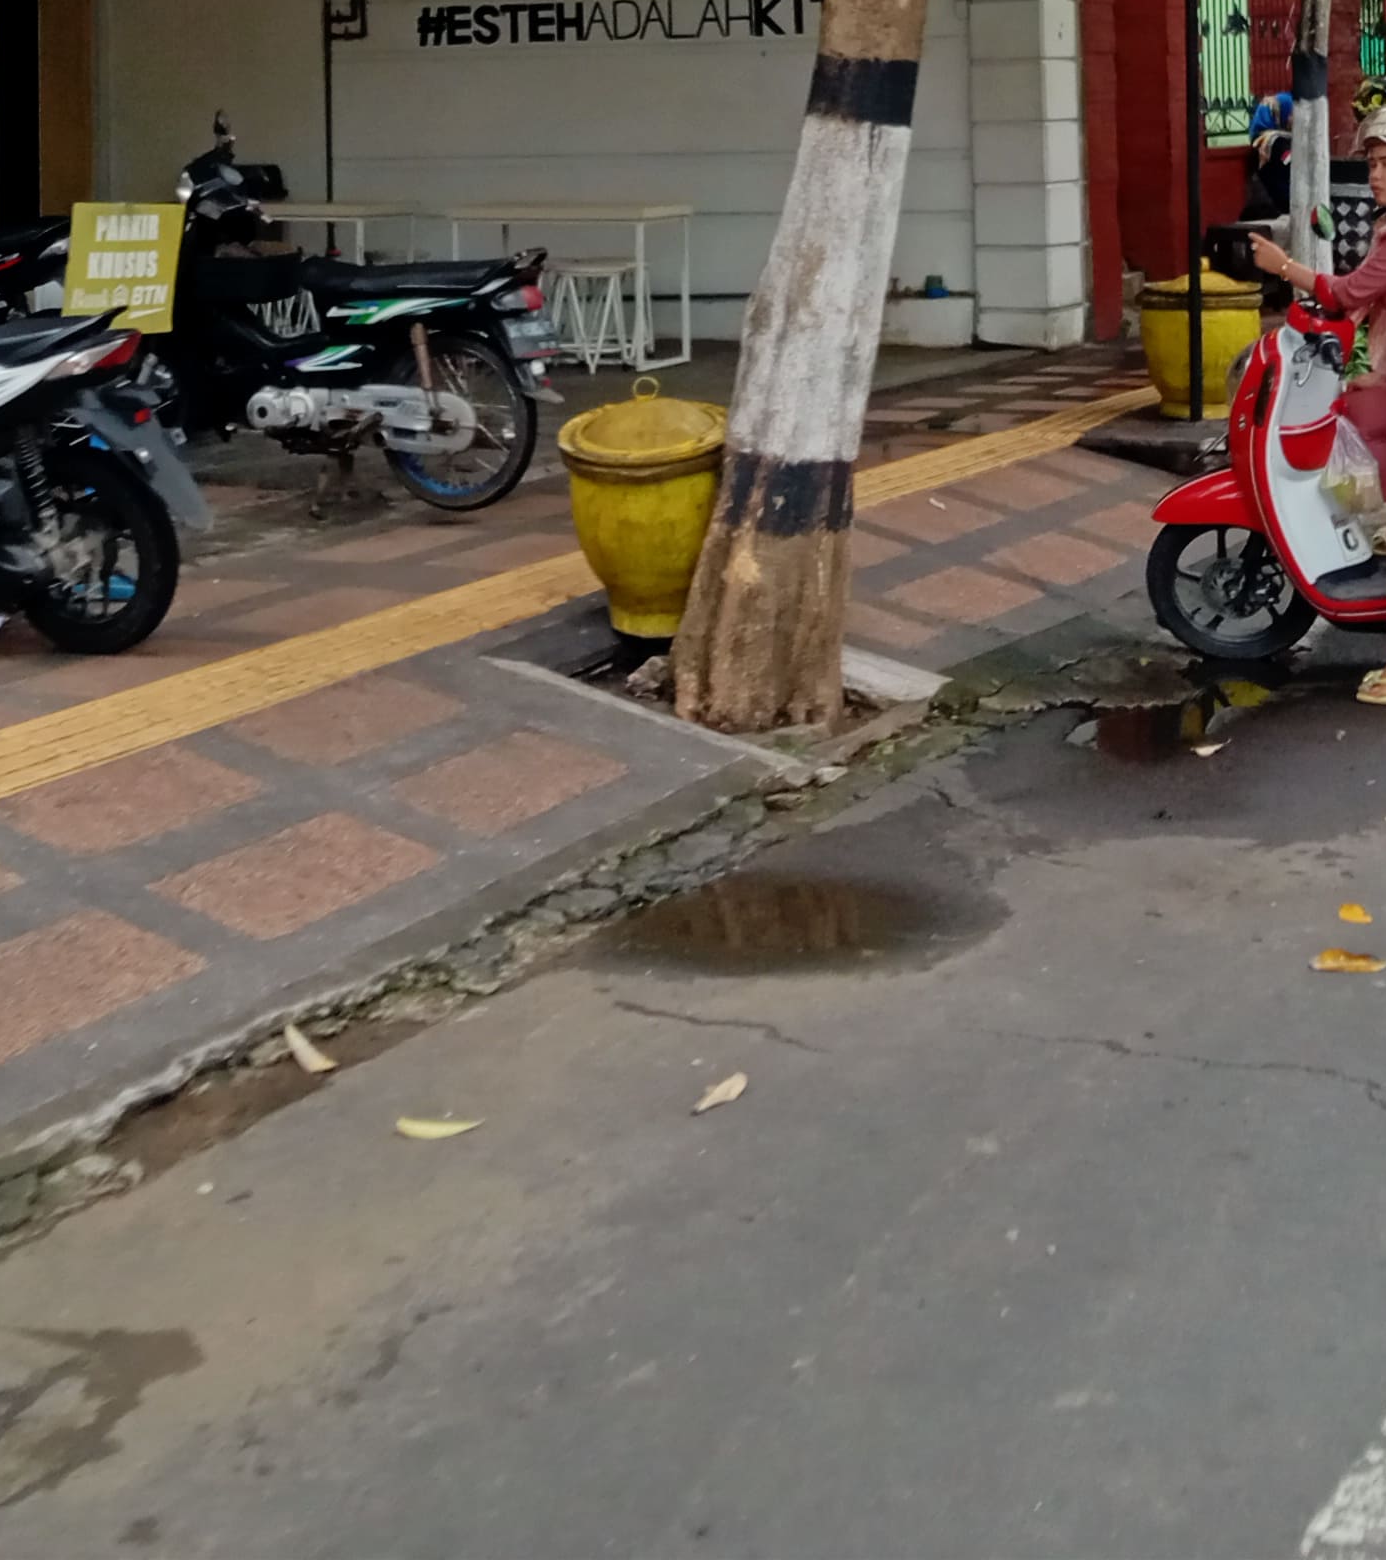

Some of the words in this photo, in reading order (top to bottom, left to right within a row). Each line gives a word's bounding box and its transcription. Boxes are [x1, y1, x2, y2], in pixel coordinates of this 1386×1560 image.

[95, 214, 160, 242] PARKIR
[87, 250, 158, 279] KHUSUS
[130, 284, 168, 306] BTN
